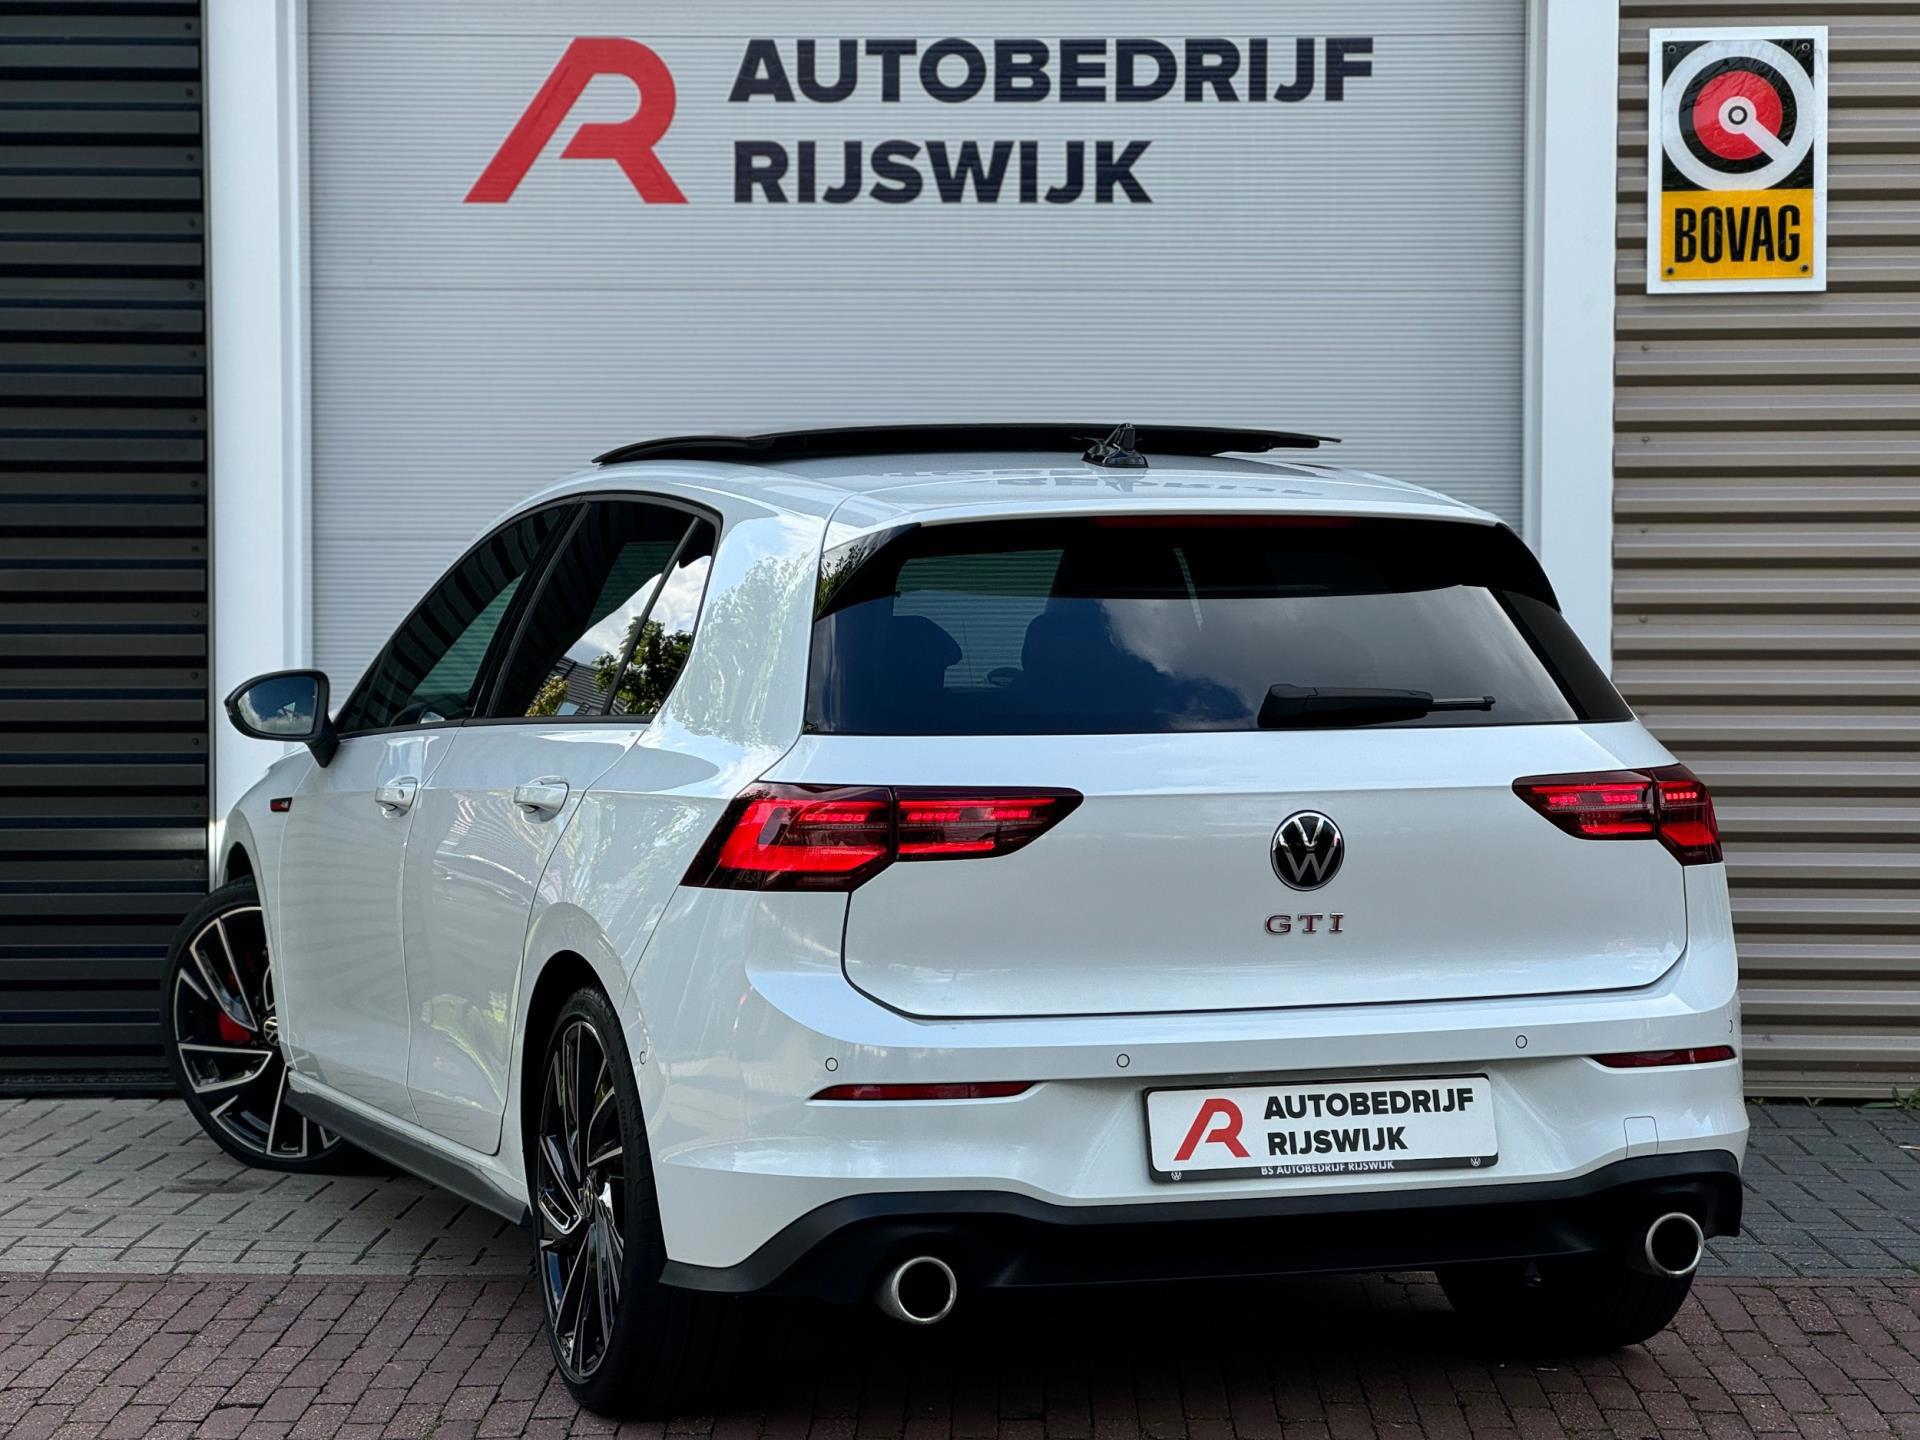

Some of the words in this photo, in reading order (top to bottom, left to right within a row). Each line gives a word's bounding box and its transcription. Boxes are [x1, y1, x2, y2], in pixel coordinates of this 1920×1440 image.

[729, 37, 1374, 103] AUTOBEDRIJF
[734, 139, 1153, 204] RIJSWIJK
[1674, 205, 1801, 264] BOVAG
[1264, 912, 1345, 935] GTI
[1263, 1088, 1474, 1120] AUTOBEDRIJF
[1267, 1126, 1408, 1156] RIJSWIJK
[1261, 1166, 1274, 1176] BS
[1276, 1162, 1346, 1175] AUTOBEDRIJF
[1348, 1160, 1395, 1171] RIJSWIJK
